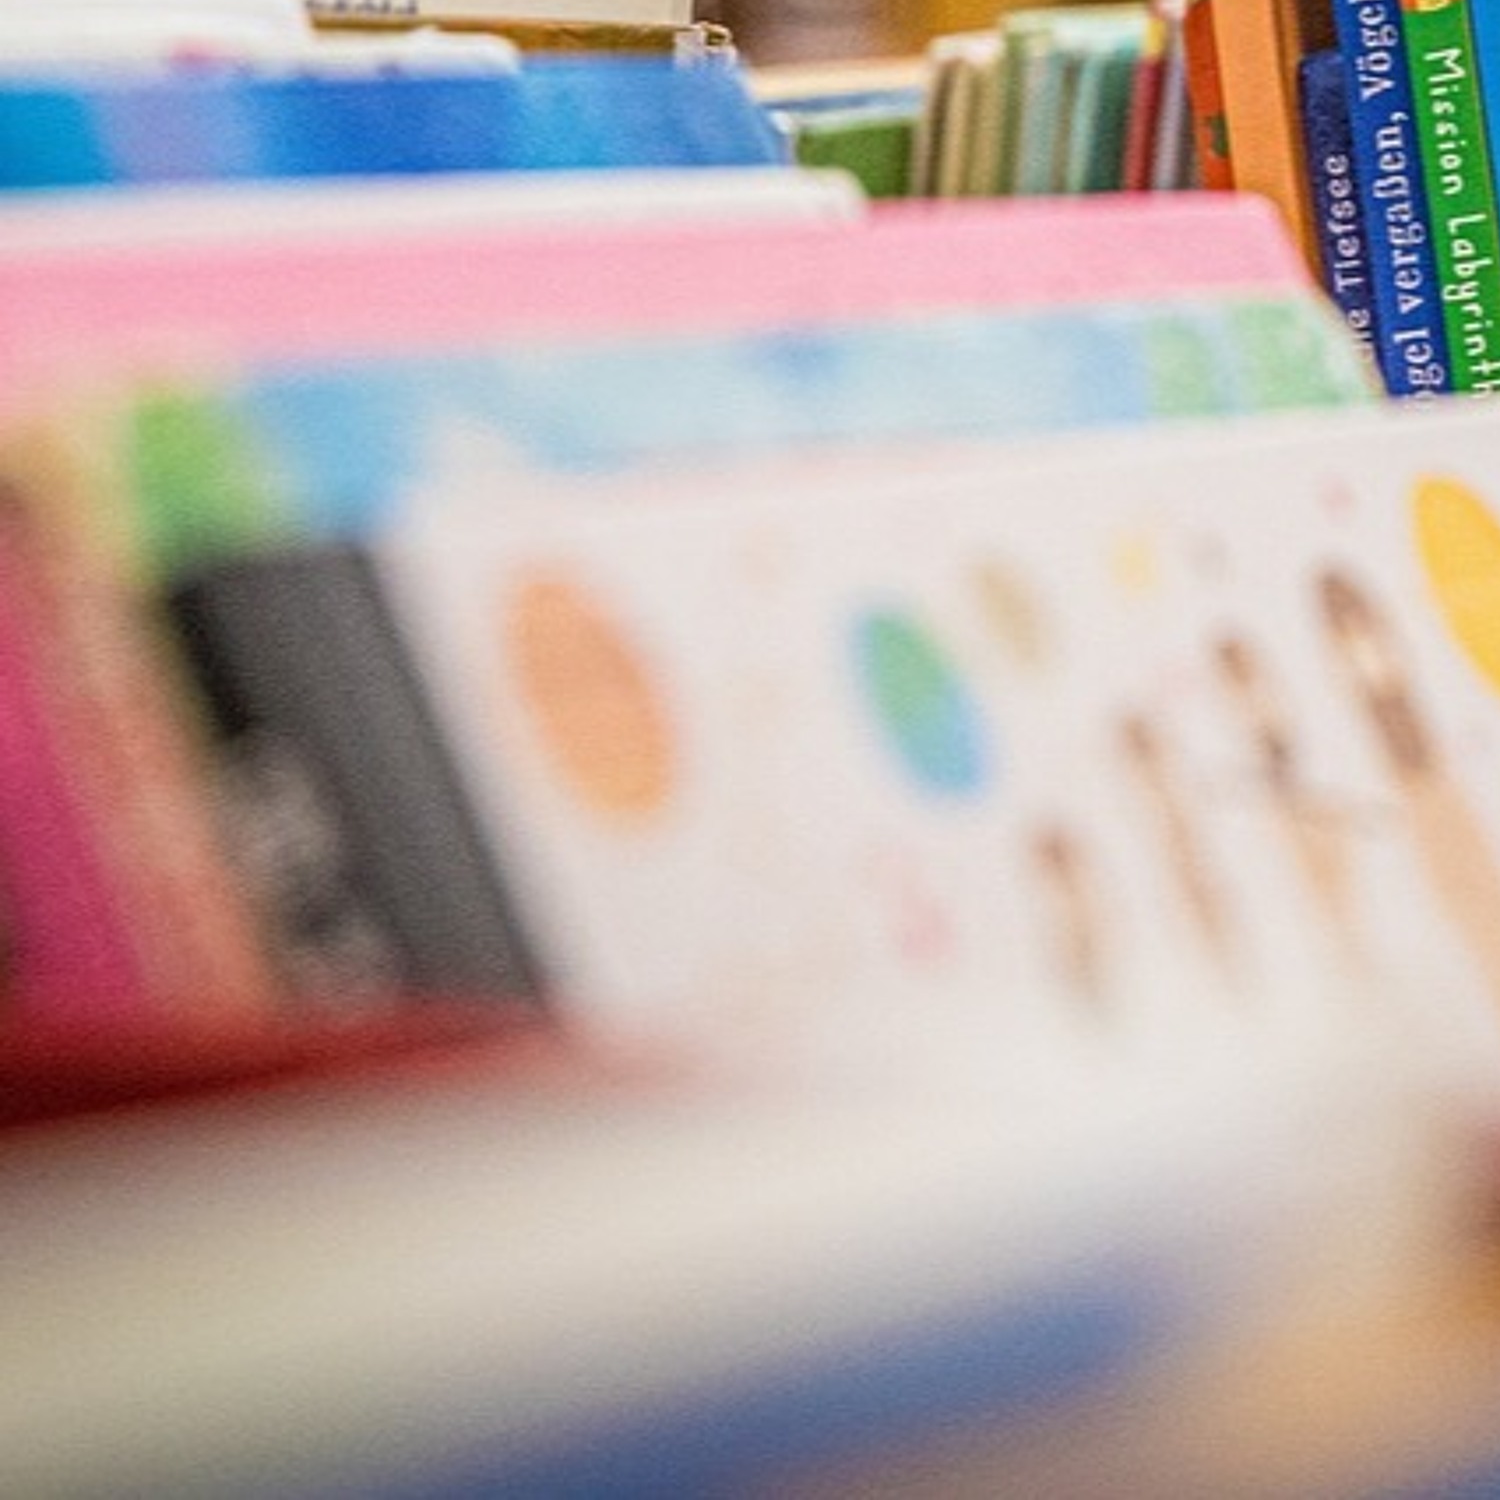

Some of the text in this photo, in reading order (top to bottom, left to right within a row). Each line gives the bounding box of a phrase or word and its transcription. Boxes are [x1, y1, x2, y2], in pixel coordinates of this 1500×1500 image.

[1422, 47, 1467, 195] Mission
[1323, 153, 1365, 295] Tiefsee
[1372, 111, 1427, 315] vergaßen,
